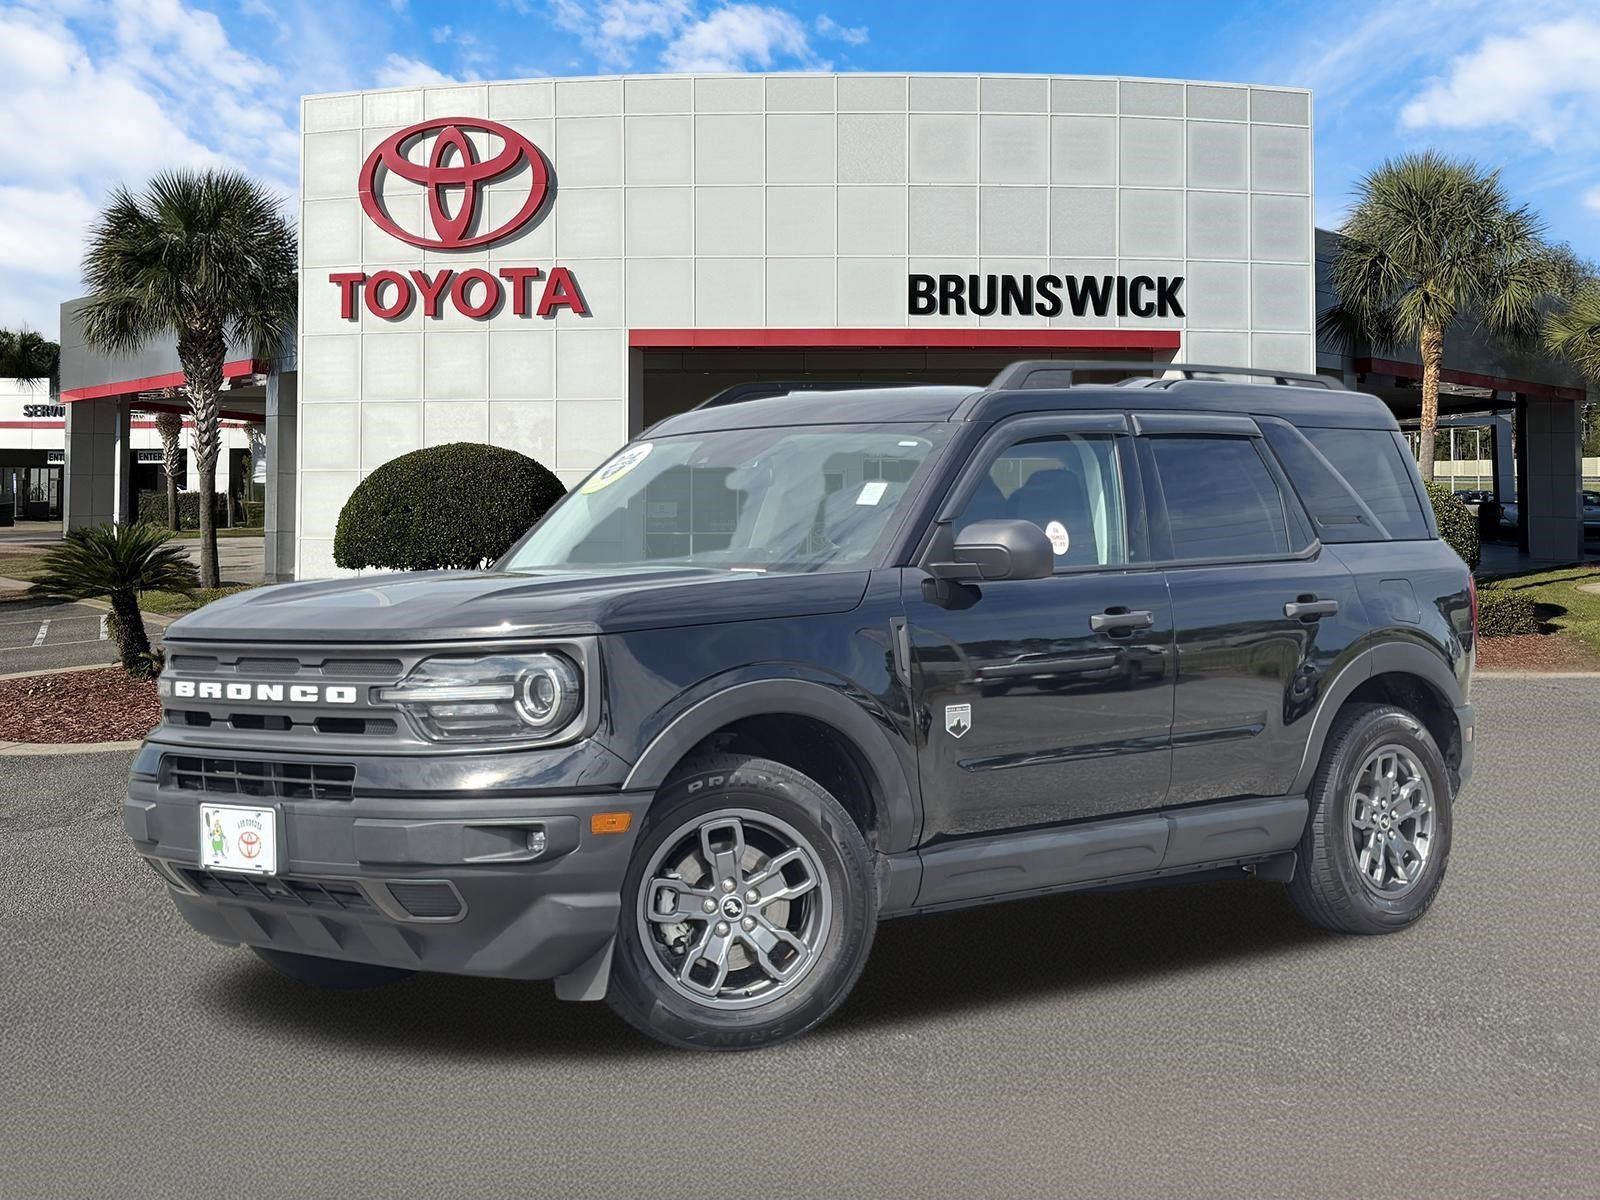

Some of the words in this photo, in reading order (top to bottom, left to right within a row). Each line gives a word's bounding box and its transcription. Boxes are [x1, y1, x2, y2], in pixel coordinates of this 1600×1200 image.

[329, 267, 589, 319] TOYOTA
[908, 274, 1186, 317] BRUNSWICK
[174, 681, 357, 704] BRONCO
